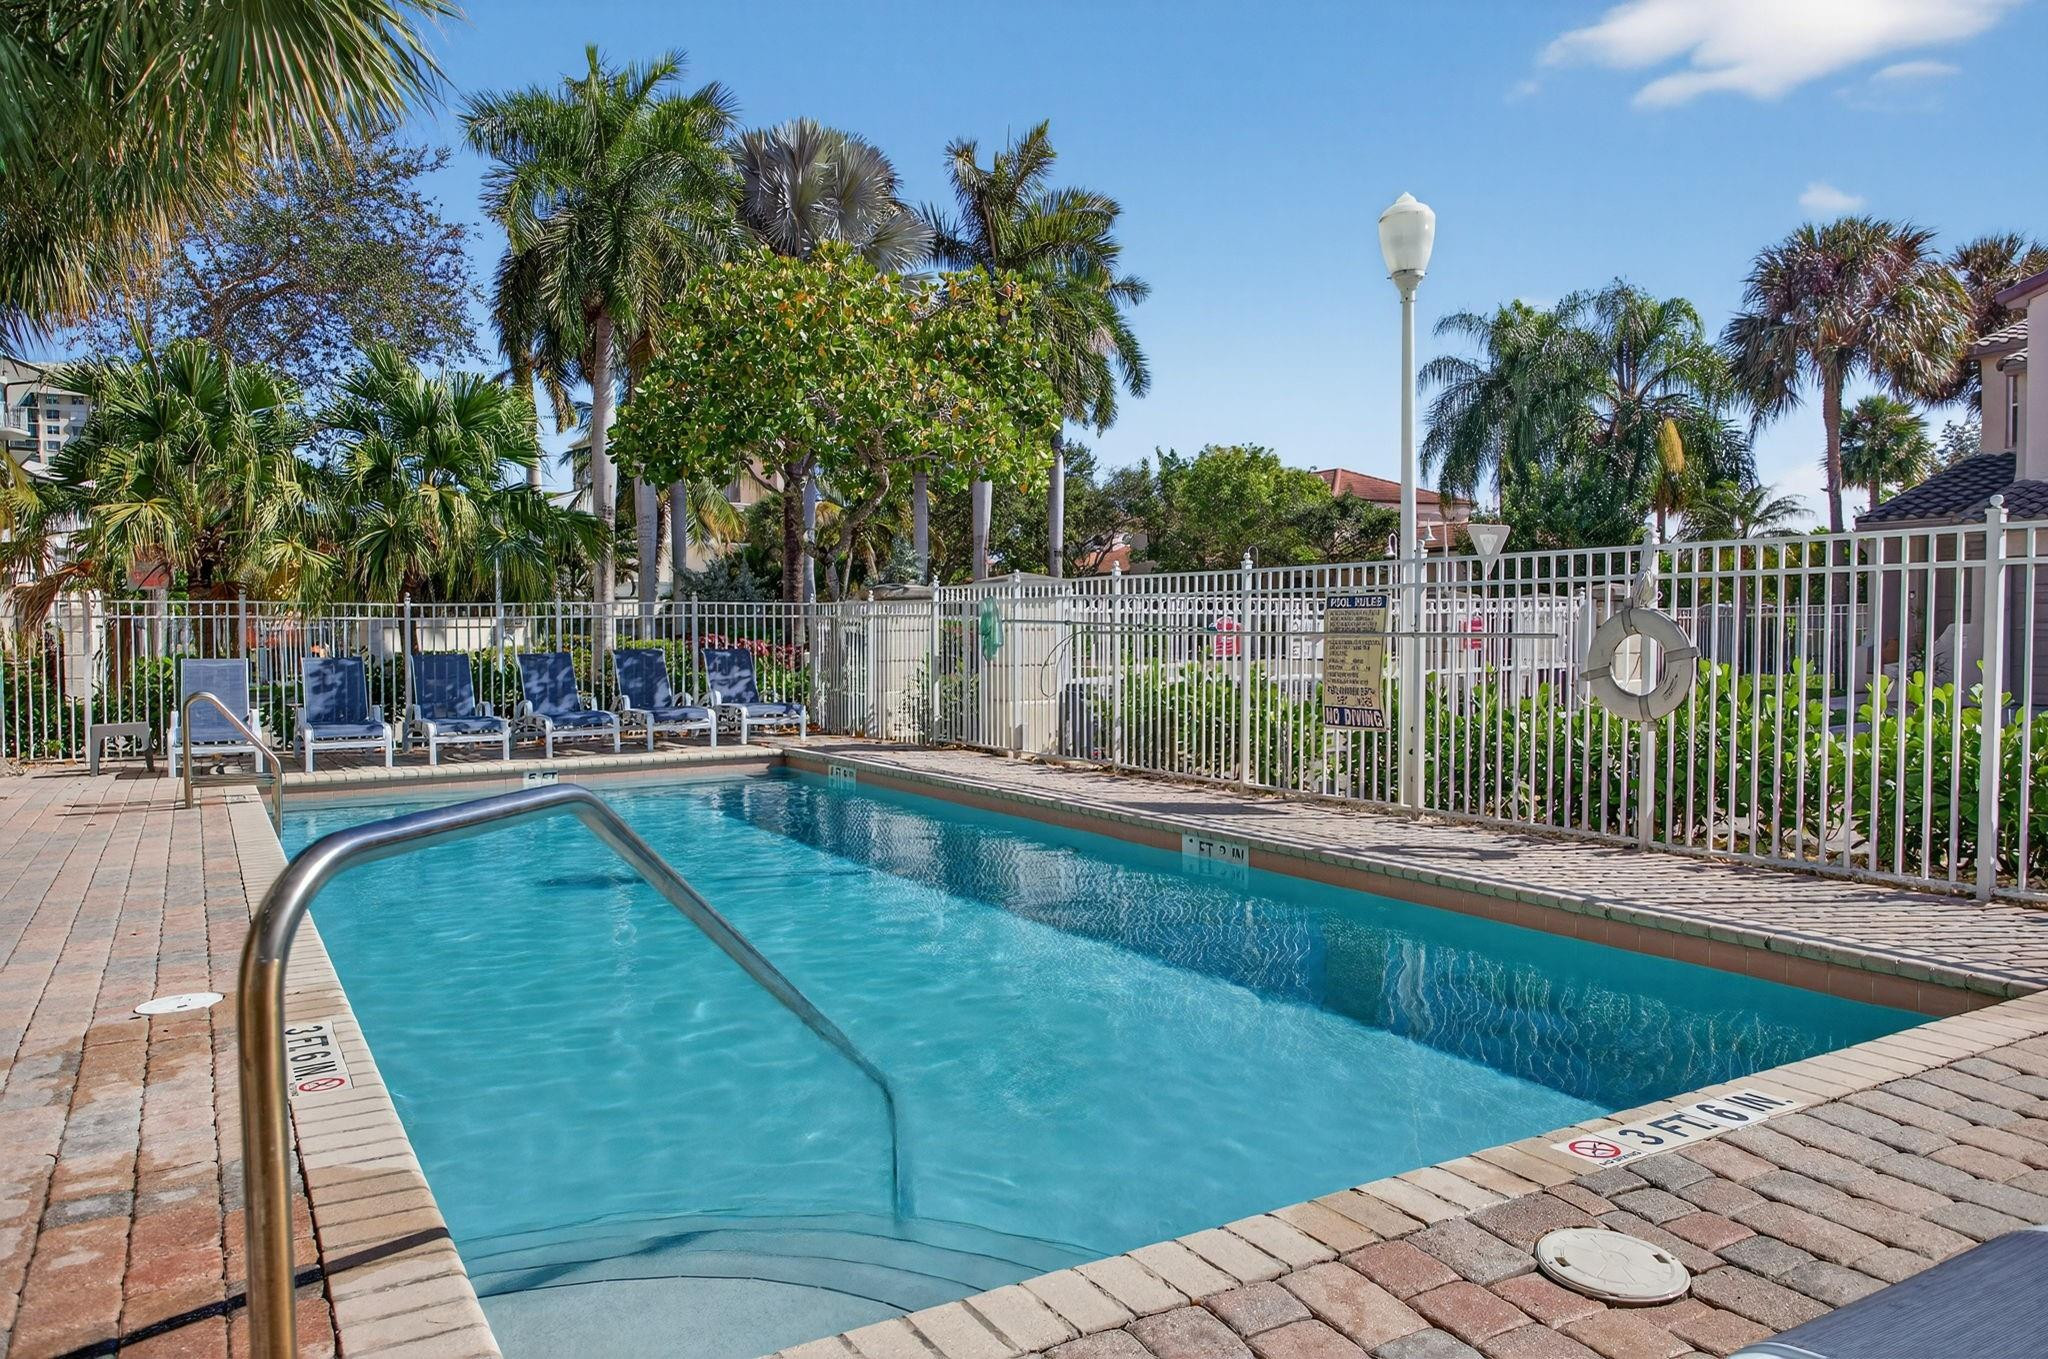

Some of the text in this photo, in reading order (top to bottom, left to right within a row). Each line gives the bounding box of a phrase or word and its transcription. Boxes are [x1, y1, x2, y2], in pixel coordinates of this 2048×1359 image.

[1330, 596, 1383, 608] POOL RULES
[1325, 706, 1383, 727] NO DIVING
[284, 1025, 324, 1035] 3
[290, 1050, 332, 1063] 6
[293, 1060, 338, 1081] IN.
[1618, 1091, 1795, 1146] 3 FT. 6 IN.
